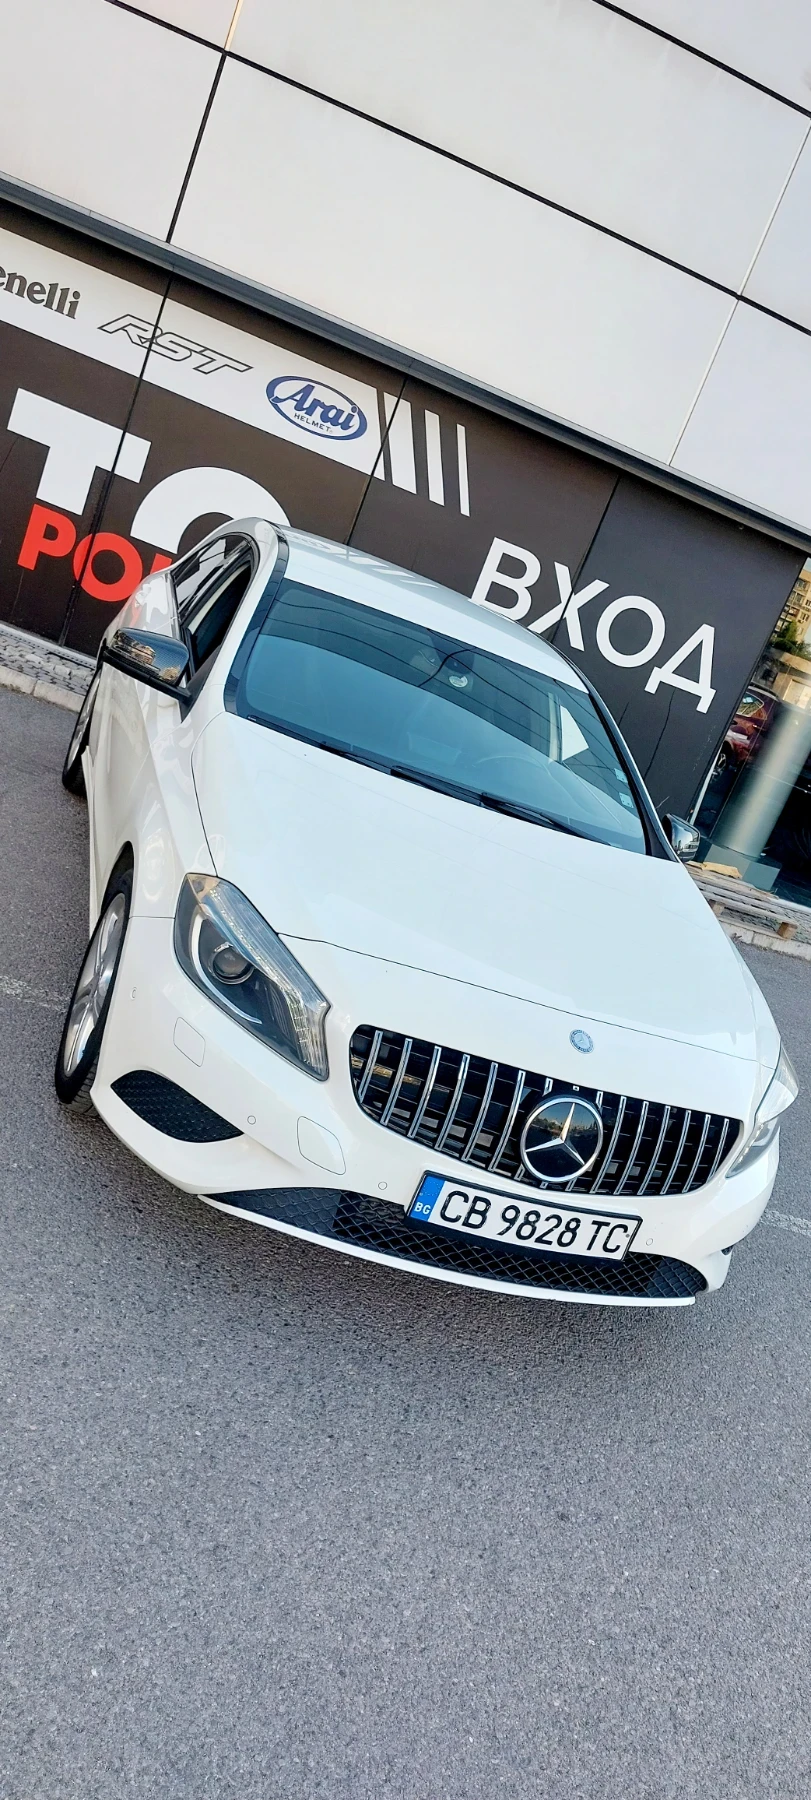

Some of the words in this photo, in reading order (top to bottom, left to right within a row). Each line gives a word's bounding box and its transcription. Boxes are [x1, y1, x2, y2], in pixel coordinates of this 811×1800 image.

[97, 313, 255, 375] RST
[270, 383, 357, 431] Arai
[293, 412, 331, 433] HELMET
[17, 503, 173, 602] PO
[468, 536, 716, 714] ВХОД
[414, 1201, 431, 1215] BG
[439, 1190, 492, 1230] CB
[496, 1204, 582, 1248] 9828
[586, 1219, 629, 1254] TC
